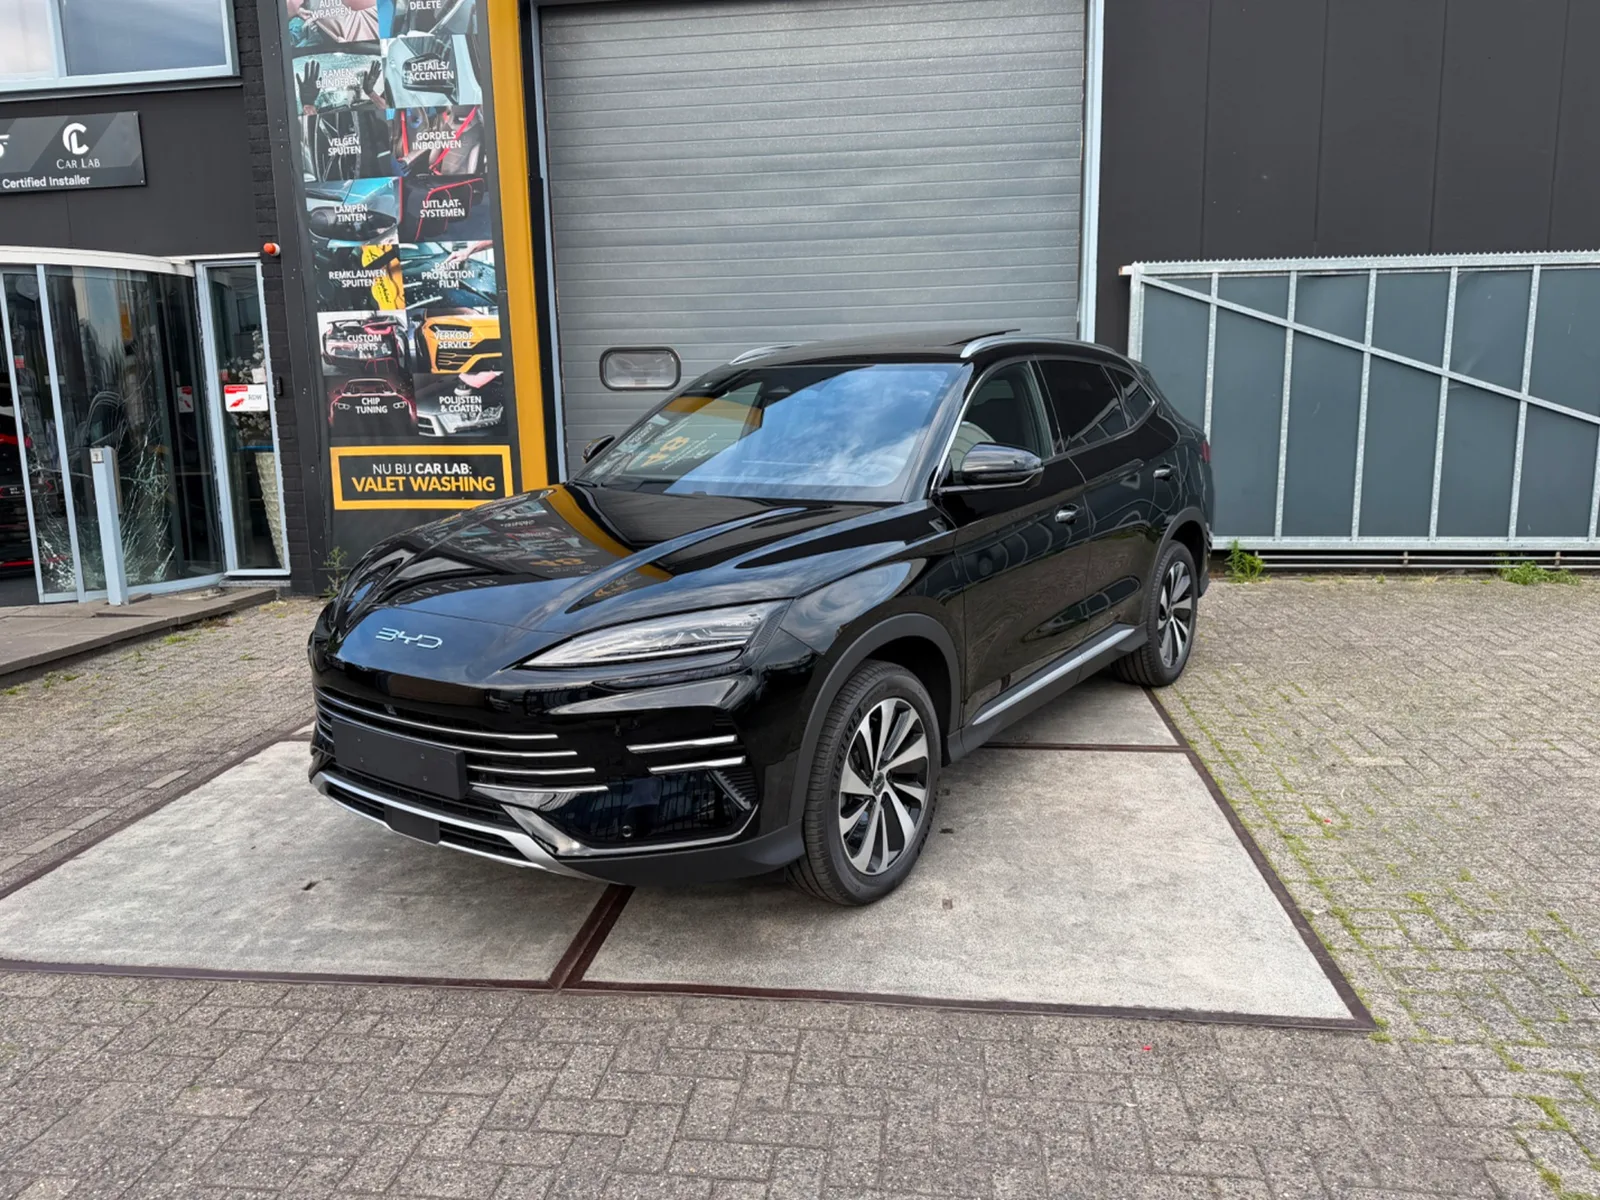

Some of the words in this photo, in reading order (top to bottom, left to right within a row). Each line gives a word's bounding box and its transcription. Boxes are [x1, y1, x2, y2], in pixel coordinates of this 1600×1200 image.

[319, 0, 342, 8] AUTO
[410, 0, 442, 10] DELETE
[311, 6, 352, 18] WRAPPEN
[409, 70, 454, 80] ACCENTEN
[316, 76, 360, 88] BLINDEREN
[416, 131, 456, 140] GORDELS
[328, 136, 359, 147] VELGEN
[412, 140, 462, 150] INBOUWEN
[328, 146, 362, 156] SPUITEN
[56, 158, 77, 170] CAR
[81, 158, 100, 168] LAB
[2, 176, 46, 189] Certified
[49, 174, 90, 186] Installer
[334, 204, 368, 214] LAMPEN
[423, 200, 461, 208] UITLAAT-
[337, 212, 366, 222] TINTEN
[420, 208, 465, 218] SYSTEMEN
[434, 262, 460, 271] PAINT
[329, 269, 386, 280] REMKLAUWEN
[422, 270, 475, 280] PROTECTION
[341, 278, 374, 288] SPUITEN
[439, 278, 460, 288] FILM
[347, 334, 382, 342] CUSTOM
[434, 332, 474, 340] VERKOOP
[353, 342, 378, 351] PARTS
[438, 340, 472, 349] SERVICE
[361, 397, 380, 405] CHIP
[439, 396, 482, 405] POLIJSTEN
[355, 405, 388, 414] TUNING
[440, 404, 448, 412] &
[450, 403, 482, 413] COATEN
[372, 464, 392, 474] NU
[395, 464, 412, 476] BIJ
[415, 464, 442, 474] CAR
[444, 464, 472, 474] LAB:
[352, 478, 406, 492] VALET
[412, 476, 496, 492] WASHING
[375, 627, 443, 649] BYD
